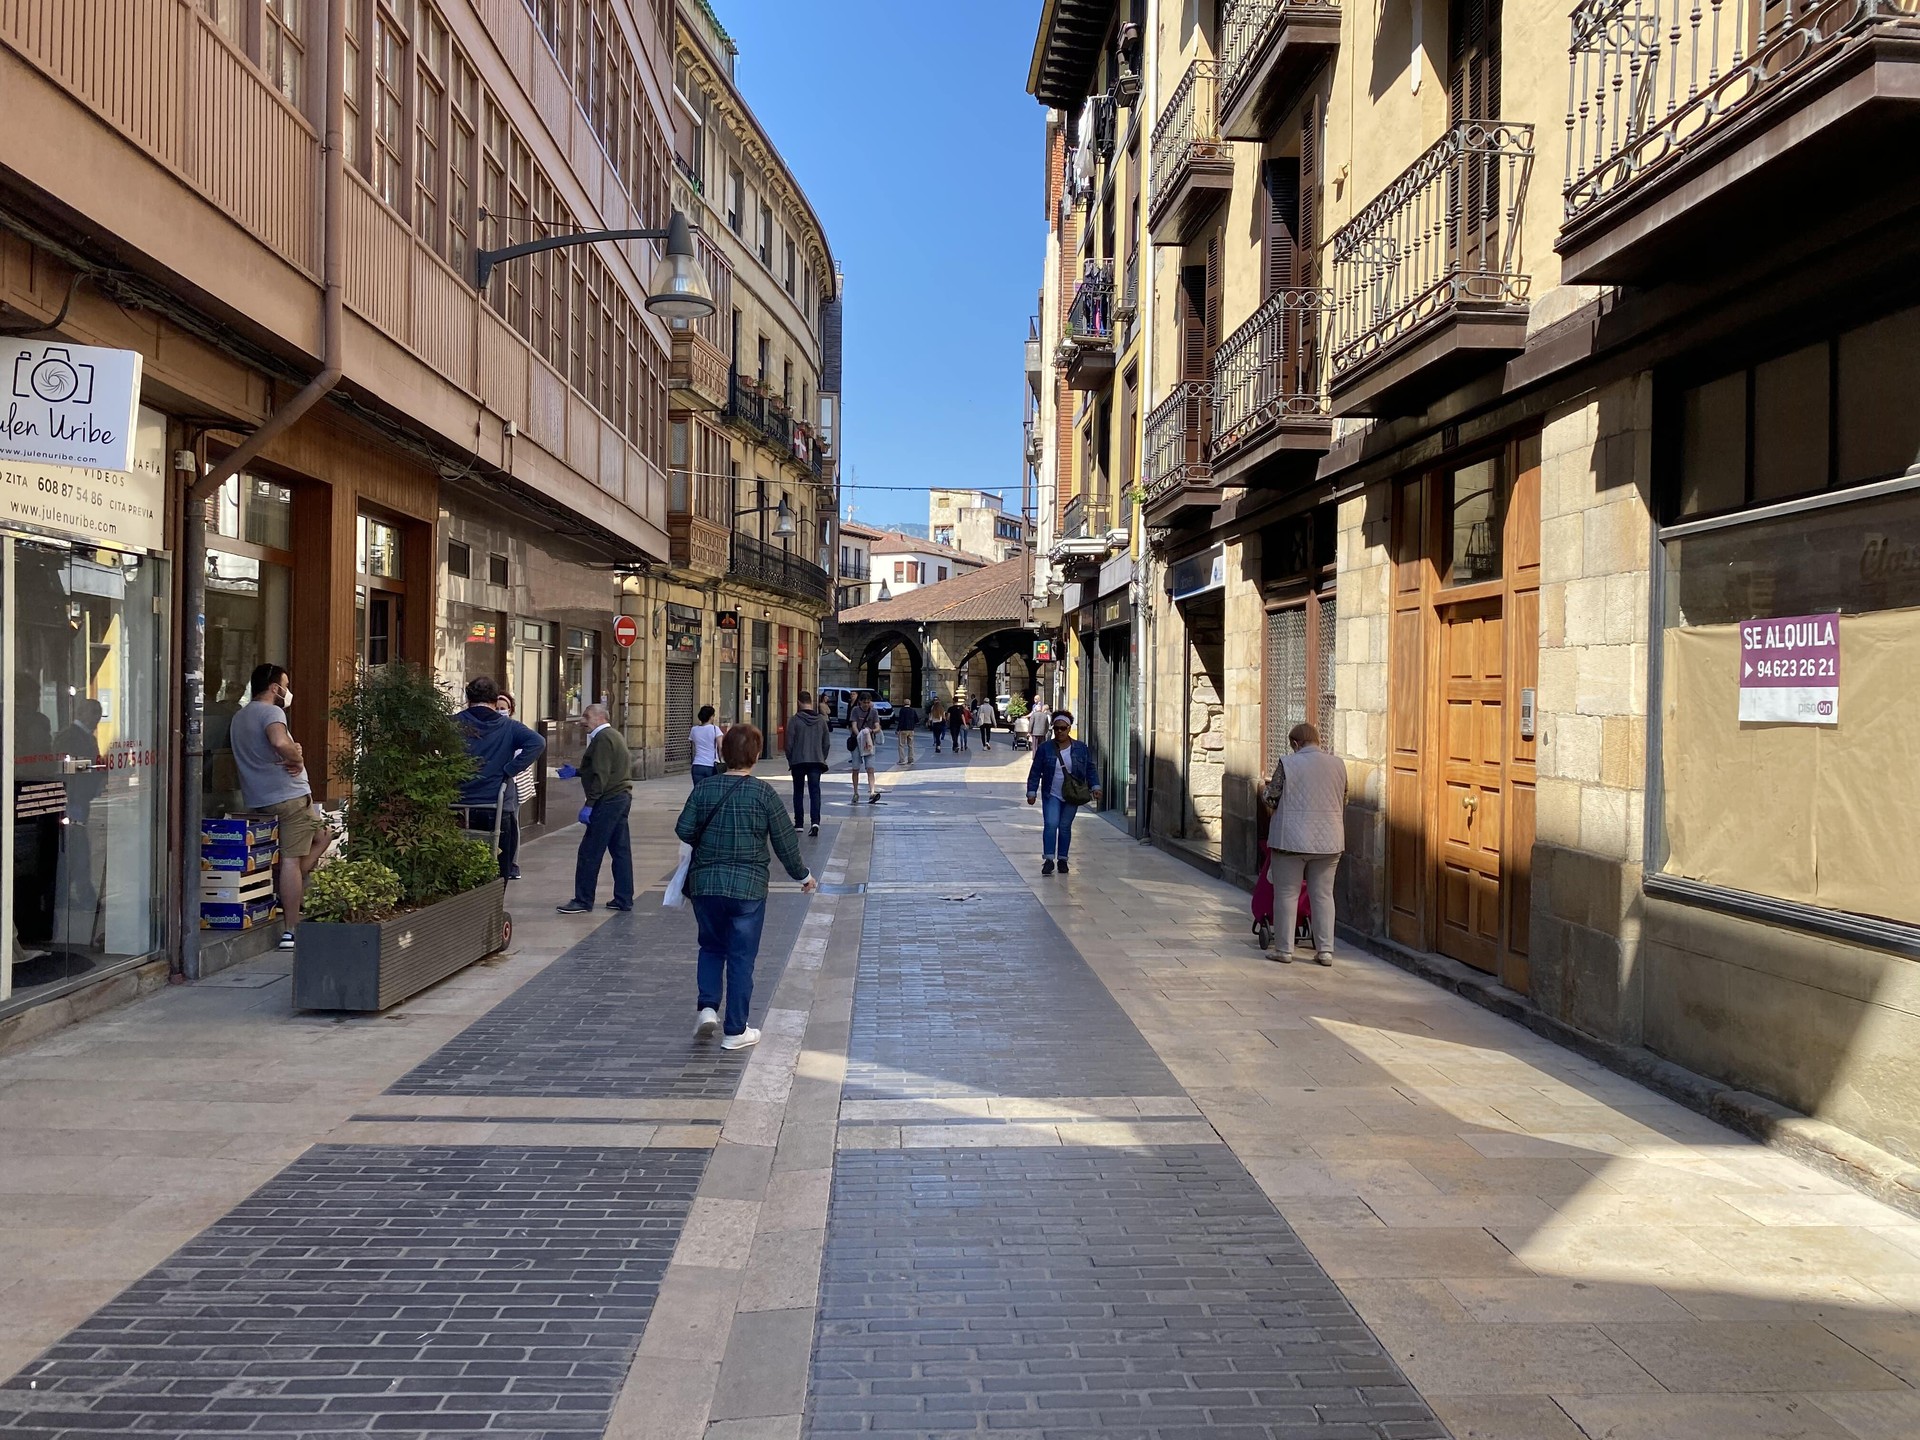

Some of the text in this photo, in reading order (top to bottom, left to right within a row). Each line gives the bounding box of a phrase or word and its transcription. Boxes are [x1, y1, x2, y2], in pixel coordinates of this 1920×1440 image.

[50, 408, 116, 445] Uribe
[6, 472, 28, 487] ZITA
[38, 477, 58, 494] 608
[61, 483, 73, 498] 87
[76, 487, 88, 502] 54
[91, 491, 103, 506] 86
[109, 500, 126, 513] CITA
[128, 504, 154, 519] PREVIA
[10, 501, 117, 534] www.julenuribe.com
[1743, 621, 1835, 650] SE ALQUILA
